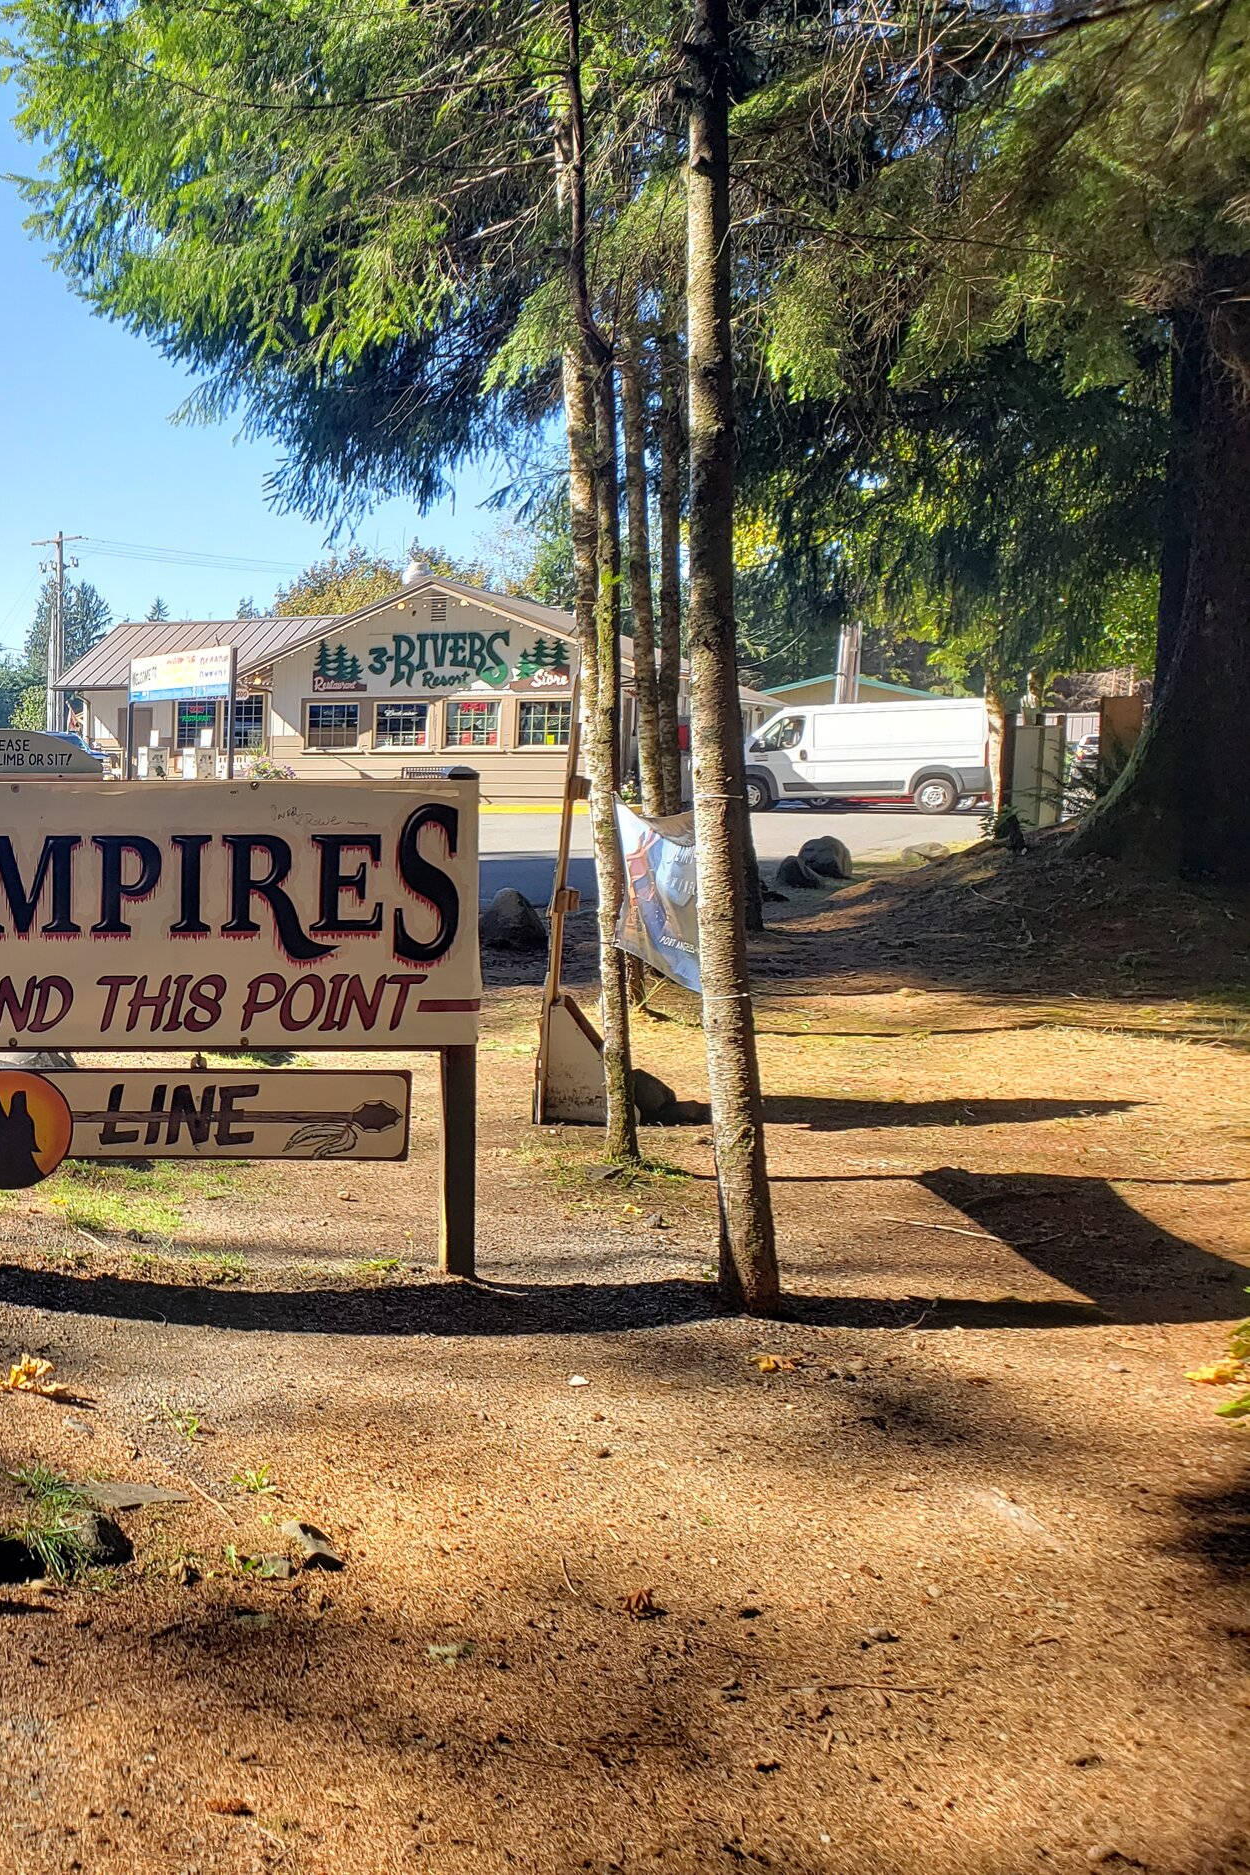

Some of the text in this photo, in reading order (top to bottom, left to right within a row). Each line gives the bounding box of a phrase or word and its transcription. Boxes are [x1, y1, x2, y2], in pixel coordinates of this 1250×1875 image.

[368, 630, 510, 688] 3-RIVERS
[313, 676, 358, 691] Restaurant
[421, 671, 470, 689] Resort
[530, 668, 568, 688] Store
[29, 754, 44, 766] OR
[47, 753, 72, 766] SIT!
[659, 935, 677, 947] PORT
[95, 973, 227, 1033] THIS
[240, 972, 429, 1032] POINT
[98, 1083, 260, 1147] LINE
